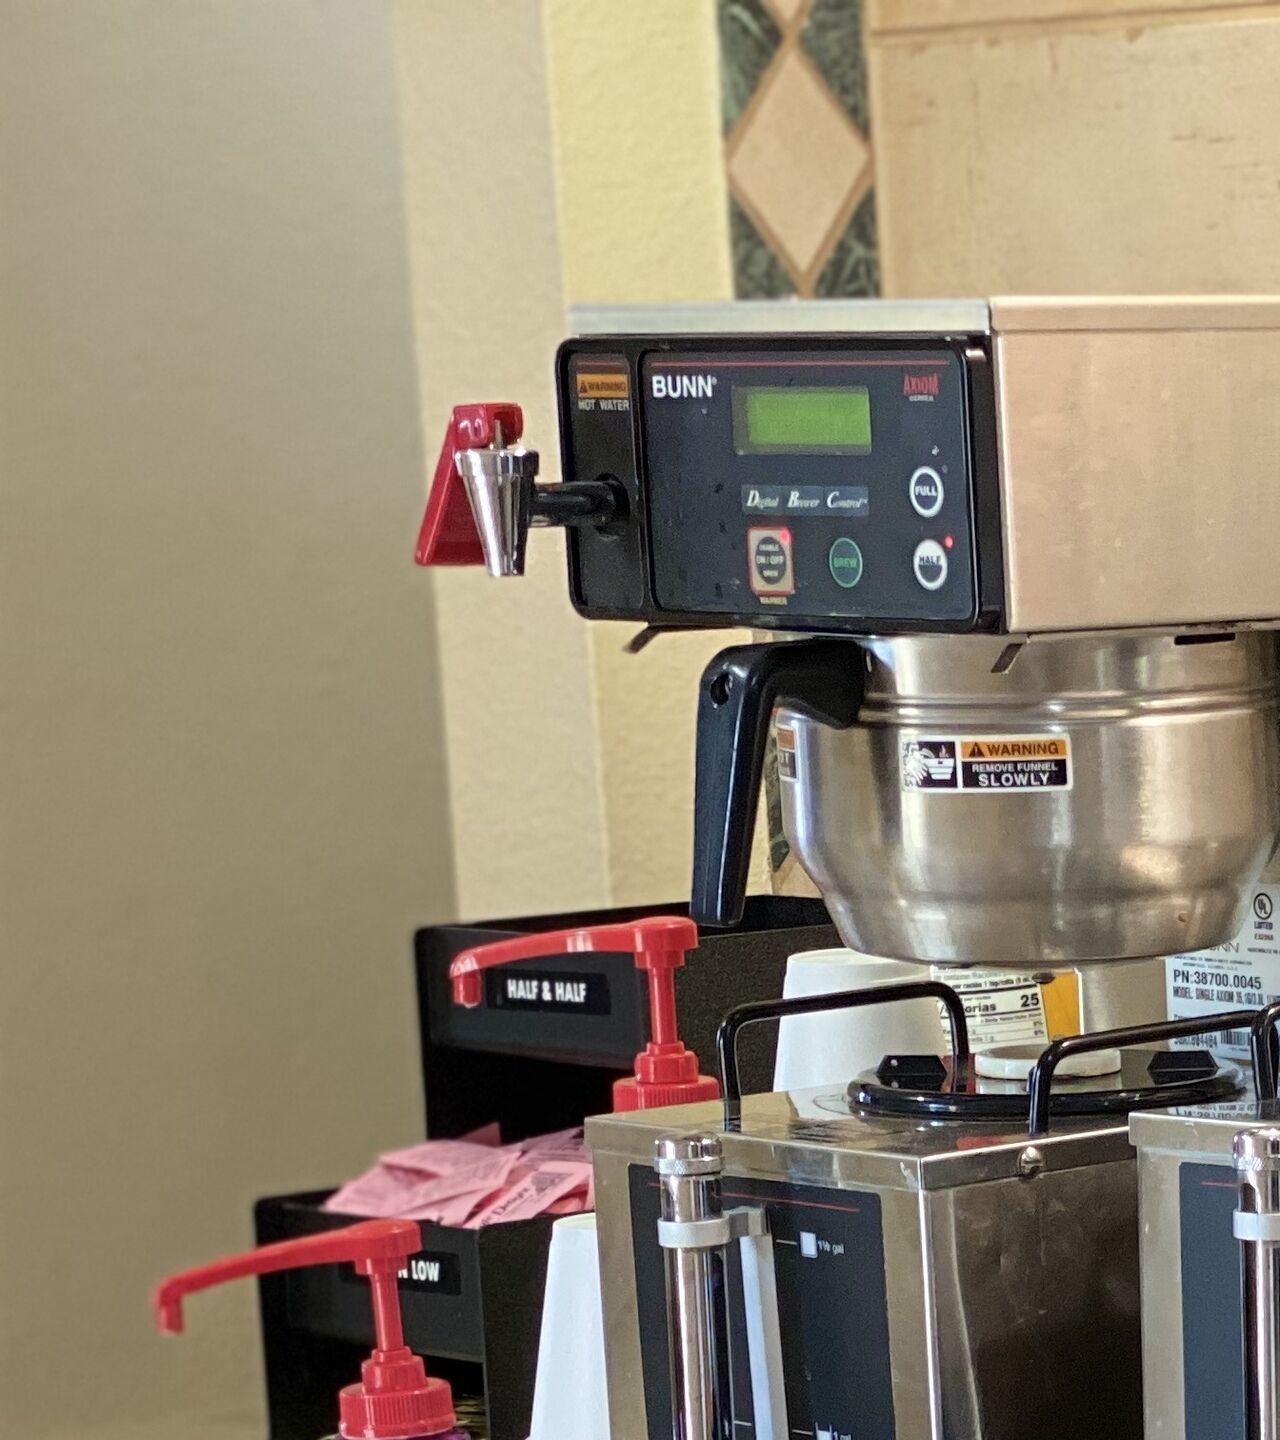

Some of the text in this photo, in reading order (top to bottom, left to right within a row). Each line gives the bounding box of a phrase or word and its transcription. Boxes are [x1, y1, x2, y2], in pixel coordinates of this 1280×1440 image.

[578, 399, 630, 411] HOT WATER
[915, 485, 938, 497] FULL
[833, 557, 857, 568] BREW
[918, 555, 942, 565] HALF
[987, 742, 1059, 757] WARNING
[972, 761, 1058, 773] REMOVE FUNNEL
[978, 773, 1050, 787] SLOWLY
[1173, 969, 1262, 990] PN:38700.0045
[507, 978, 587, 1003] HALF & HALF
[1020, 993, 1040, 1008] 25
[832, 1243, 845, 1256] gal
[411, 1260, 439, 1282] LOW
